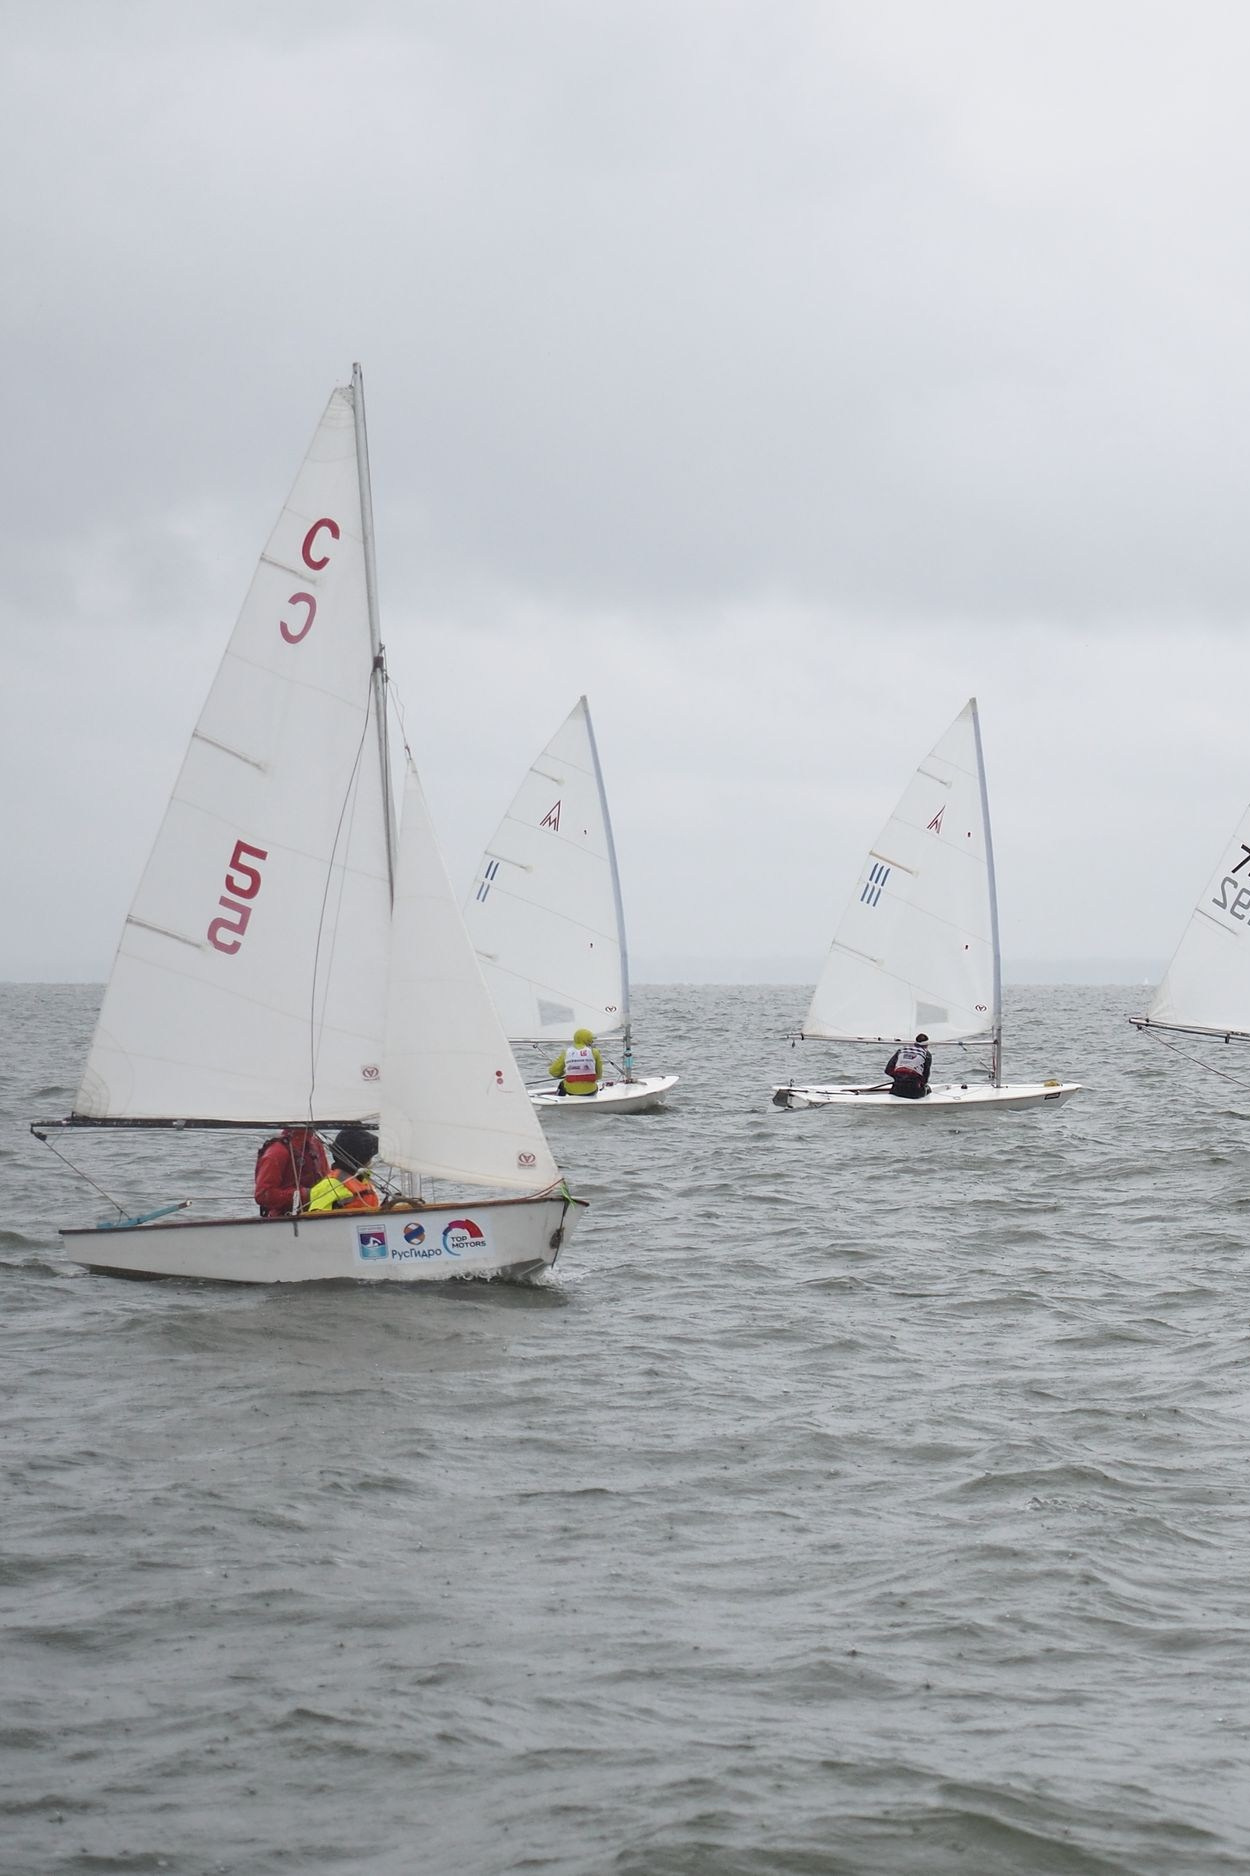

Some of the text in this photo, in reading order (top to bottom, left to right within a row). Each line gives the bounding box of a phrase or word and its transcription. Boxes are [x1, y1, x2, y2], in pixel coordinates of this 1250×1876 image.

[301, 518, 340, 571] C
[225, 840, 268, 900] 5
[391, 1248, 442, 1260] РусГидро
[452, 1240, 486, 1248] MOTORS
